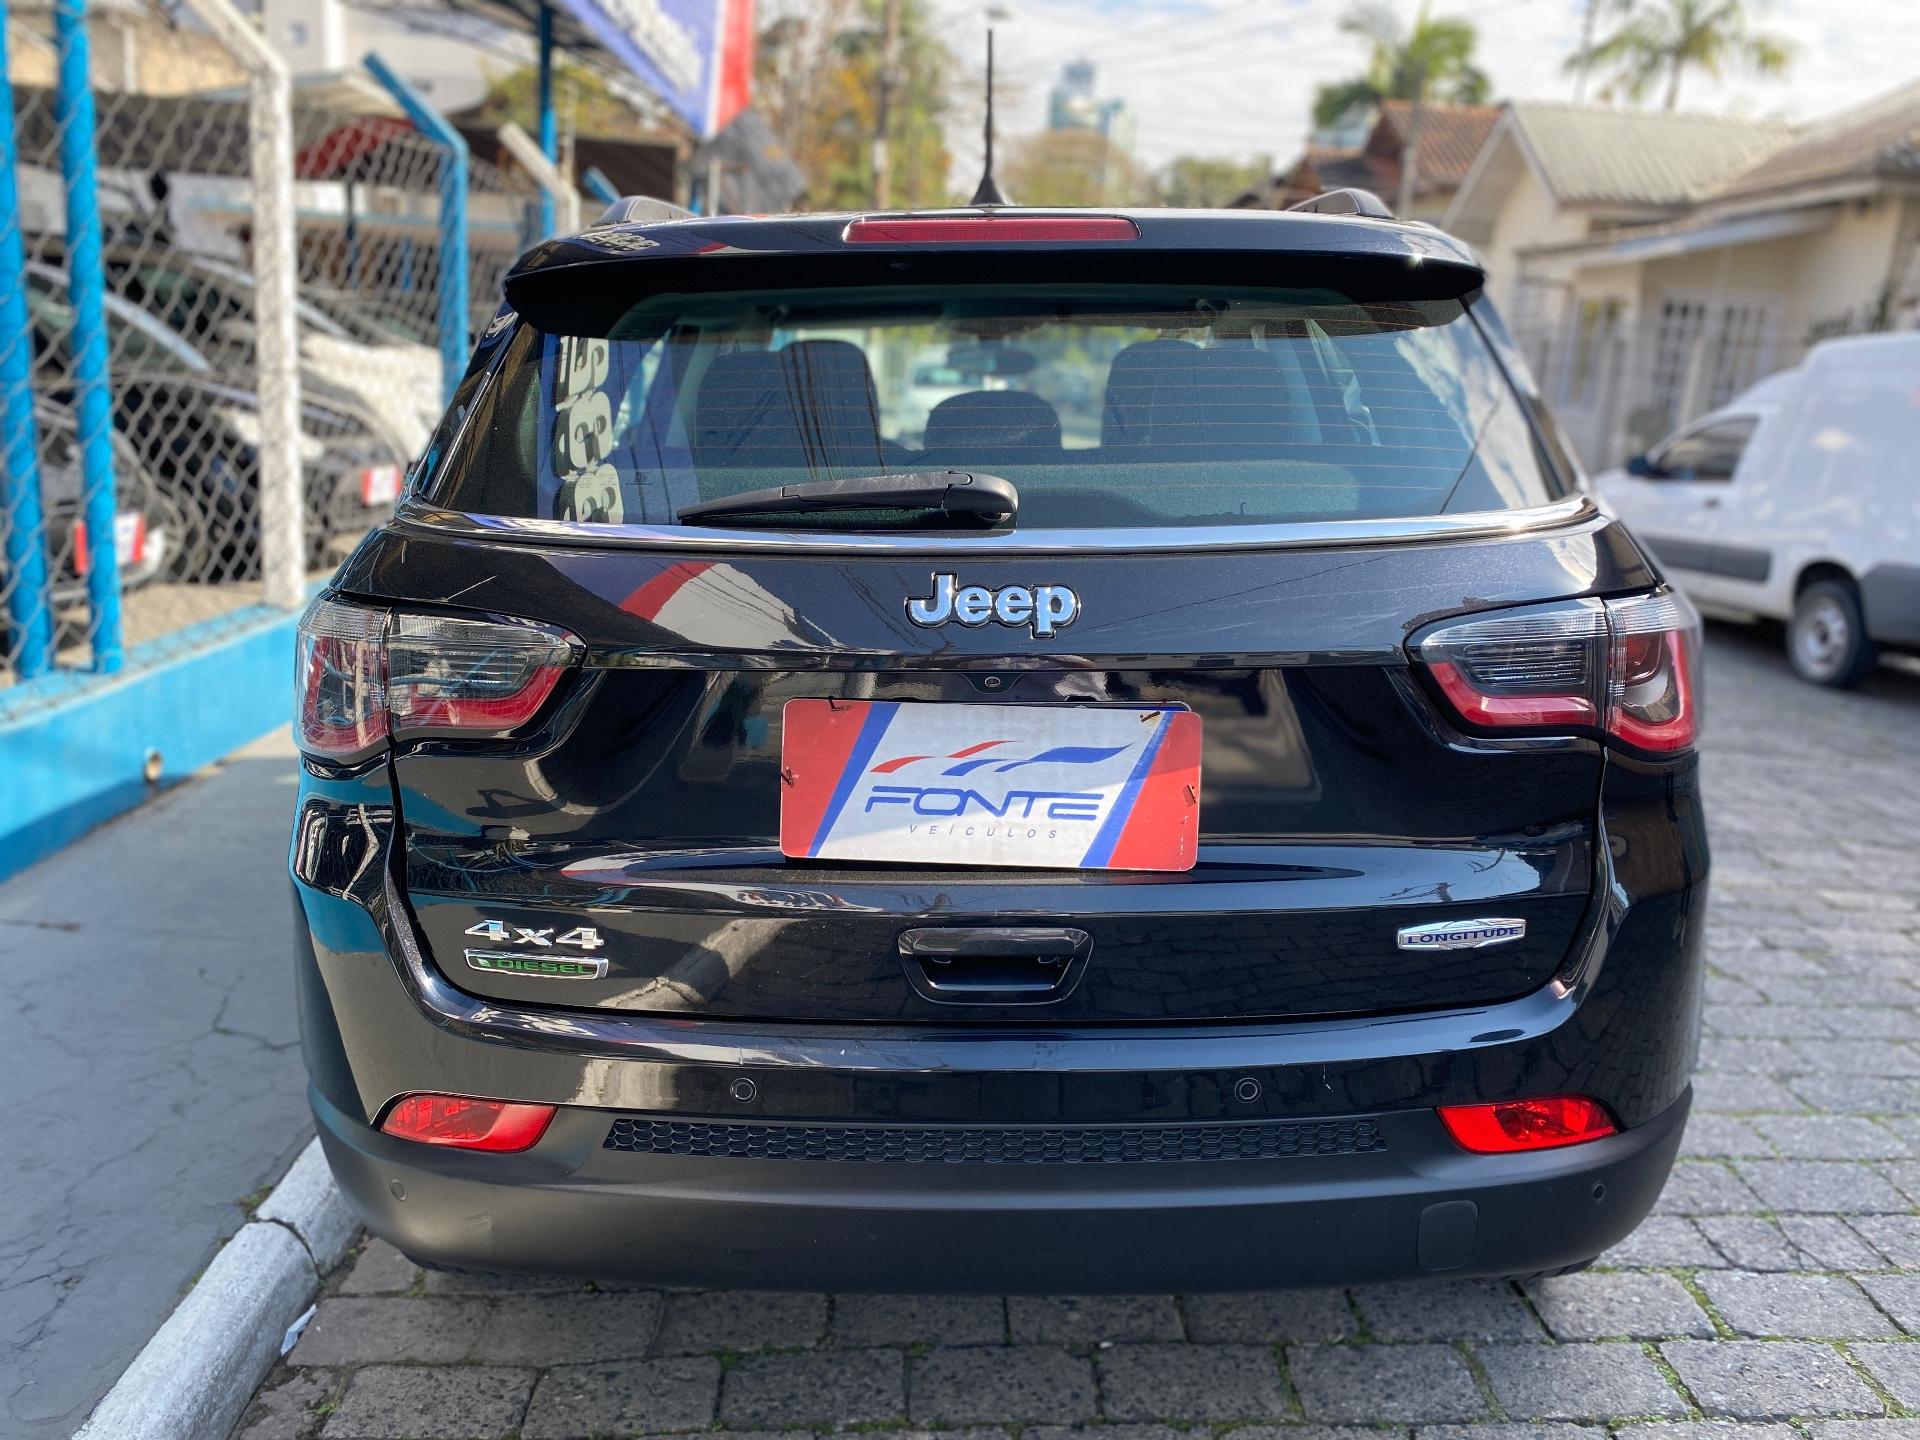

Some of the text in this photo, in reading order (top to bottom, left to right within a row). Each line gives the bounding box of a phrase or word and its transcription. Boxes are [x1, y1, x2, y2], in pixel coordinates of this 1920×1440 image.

[906, 572, 1080, 638] Jeep
[865, 786, 1104, 820] FONTE
[464, 919, 605, 950] 4x4
[1407, 927, 1520, 944] LONGITUDE
[497, 959, 594, 975] DIESEL
